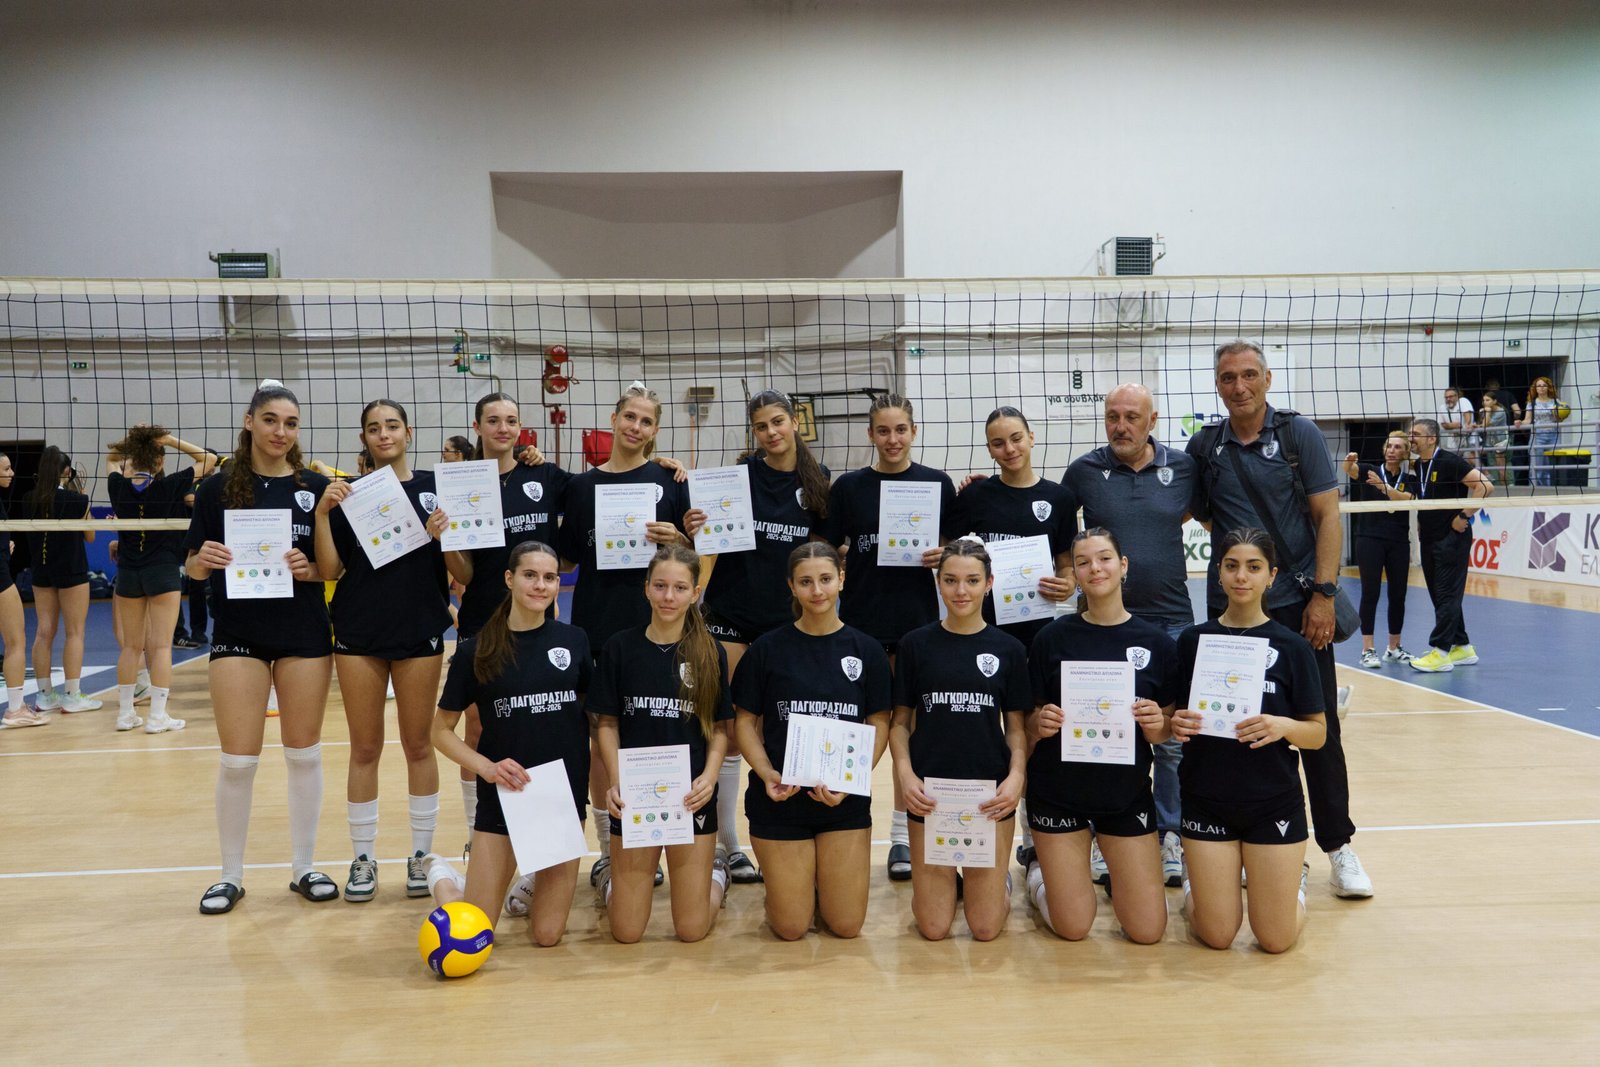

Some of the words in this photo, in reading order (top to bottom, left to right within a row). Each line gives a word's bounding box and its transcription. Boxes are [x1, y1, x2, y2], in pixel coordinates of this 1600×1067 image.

[1064, 393, 1106, 404] σουβλάκ
[494, 698, 511, 717] F4
[510, 690, 577, 709] ΠΑΓΚΟΡΑΣΙΔΩ
[530, 703, 561, 714] 2025-2026
[632, 696, 695, 714] ΠΑΓΚΟΡΑΣΙΔΩ
[790, 700, 859, 717] ΠΑΓΚΟΡΑΣΙΔΩΝ
[951, 704, 981, 713] 2025-2026
[650, 708, 680, 719] 2025-2026
